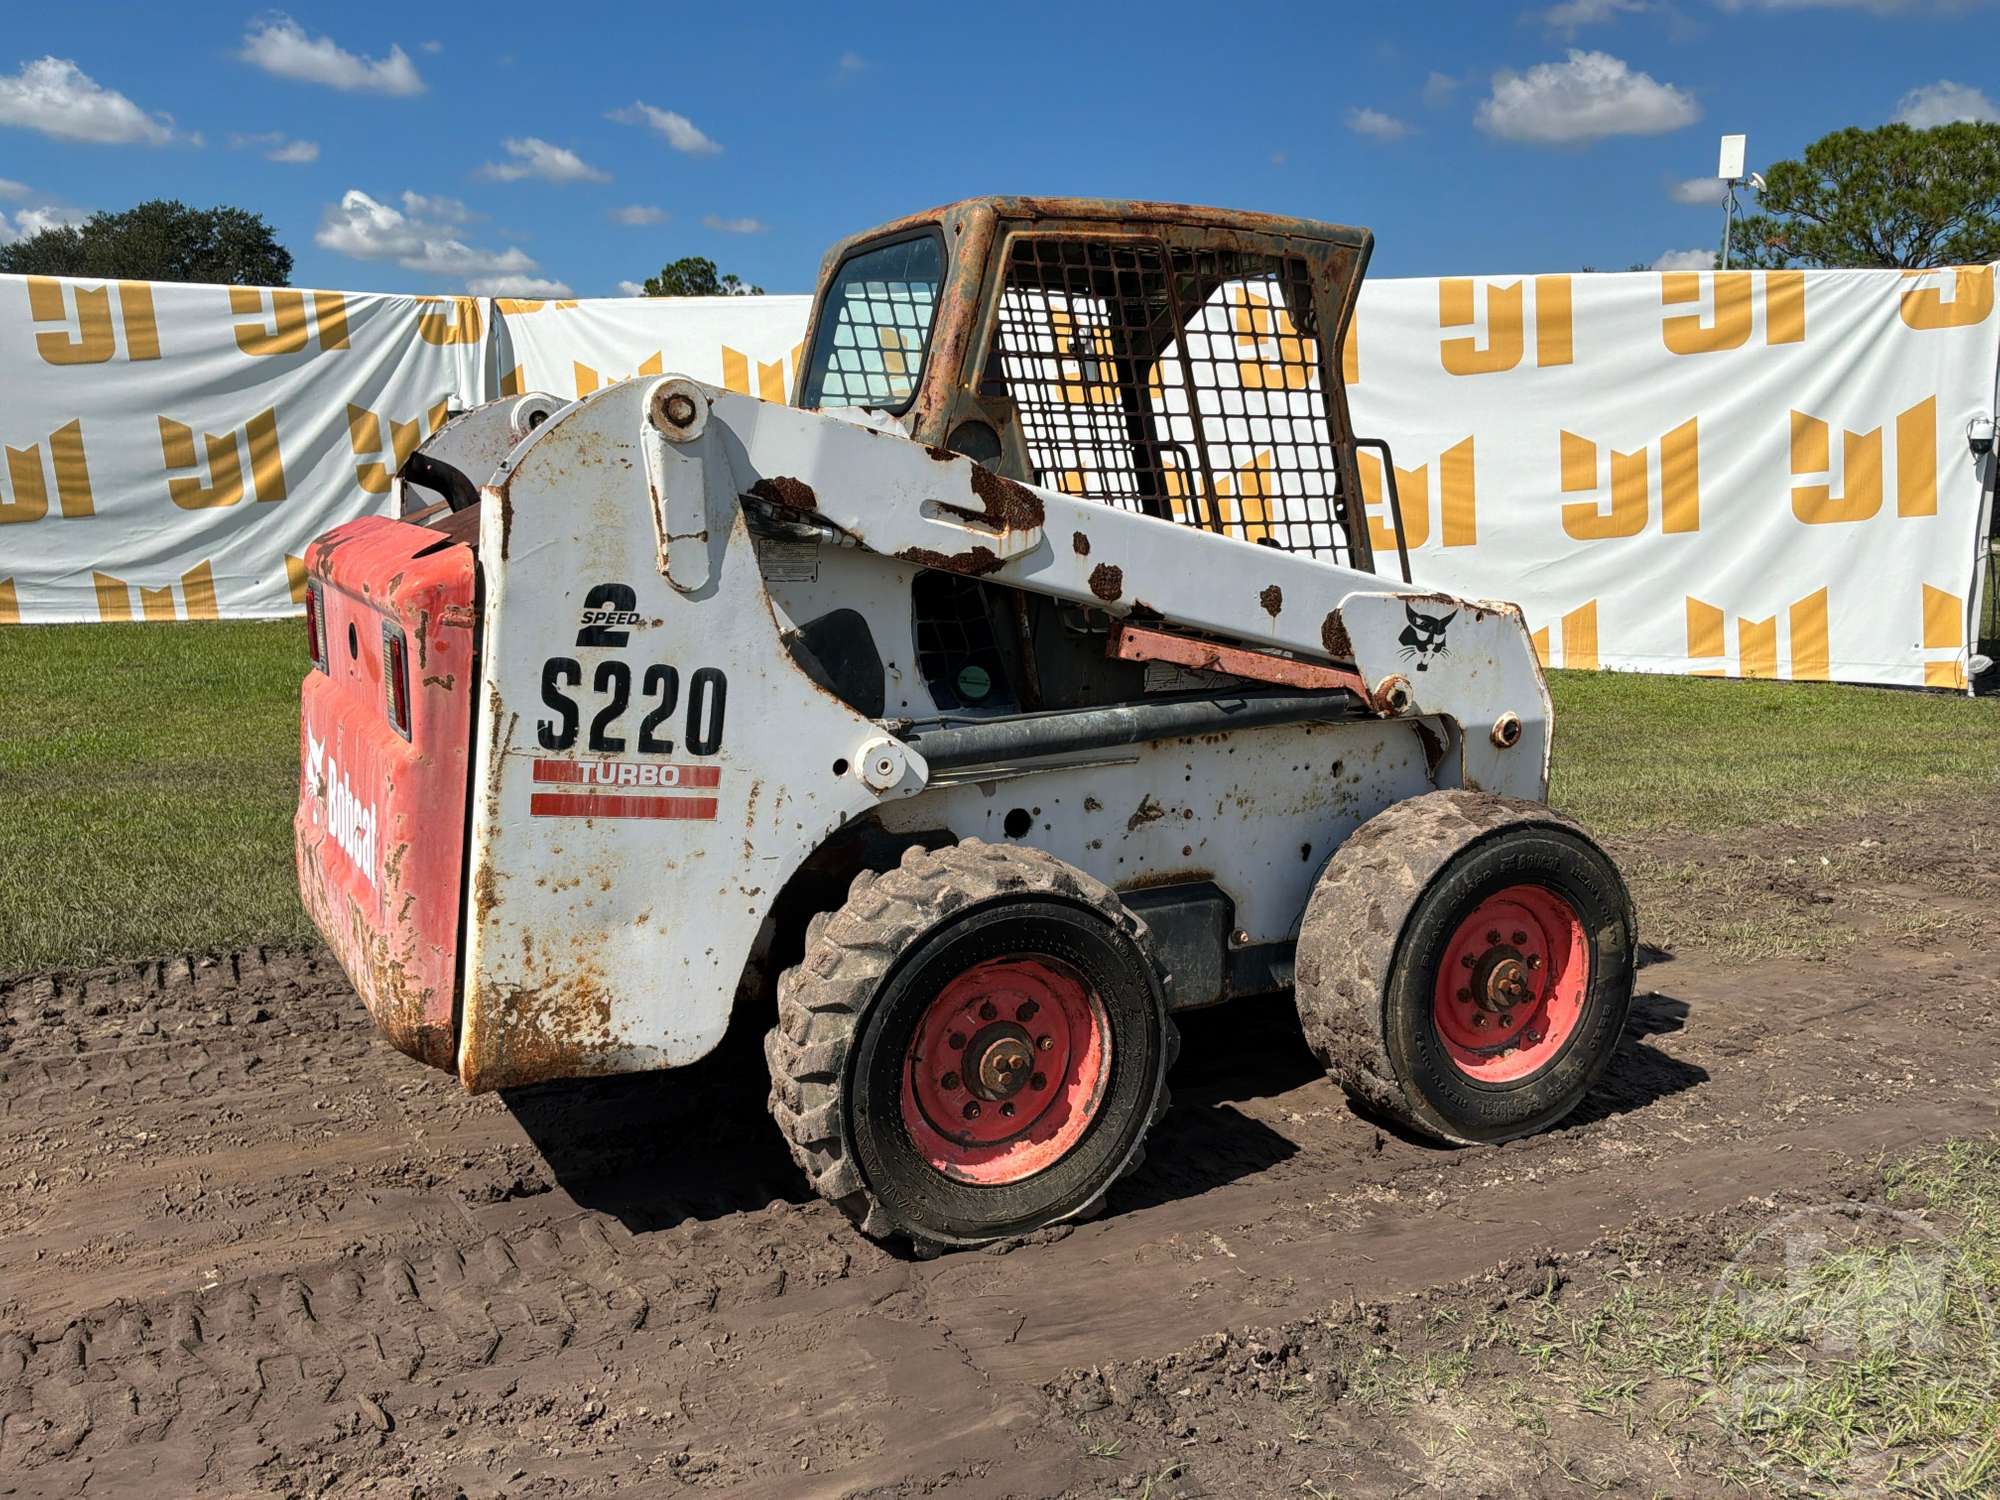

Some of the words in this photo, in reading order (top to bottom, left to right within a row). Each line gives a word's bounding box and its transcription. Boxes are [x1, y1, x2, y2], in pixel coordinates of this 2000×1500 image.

[575, 583, 637, 648] 2
[580, 611, 640, 625] SPEED
[536, 656, 728, 756] S220
[578, 762, 680, 786] TURBO
[328, 755, 376, 889] Bobcat
